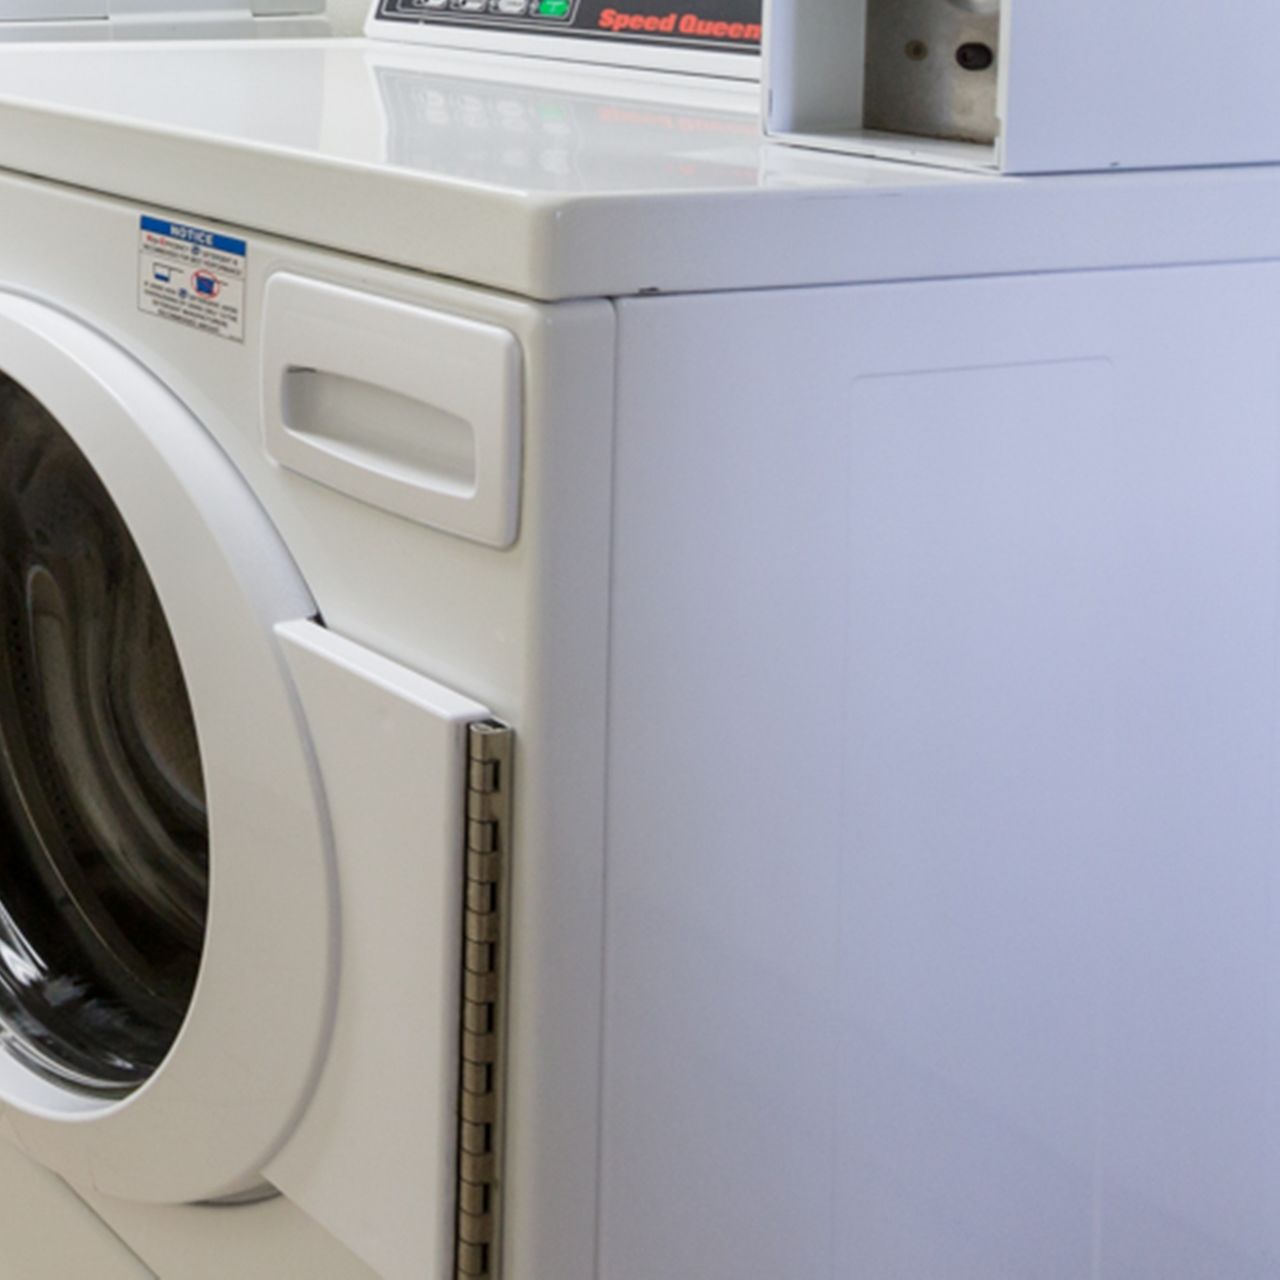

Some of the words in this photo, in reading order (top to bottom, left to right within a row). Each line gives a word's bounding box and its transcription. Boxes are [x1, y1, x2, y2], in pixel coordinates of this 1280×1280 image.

[598, 8, 676, 32] Speed
[679, 14, 762, 40] Queen
[170, 224, 214, 246] NOTICE
